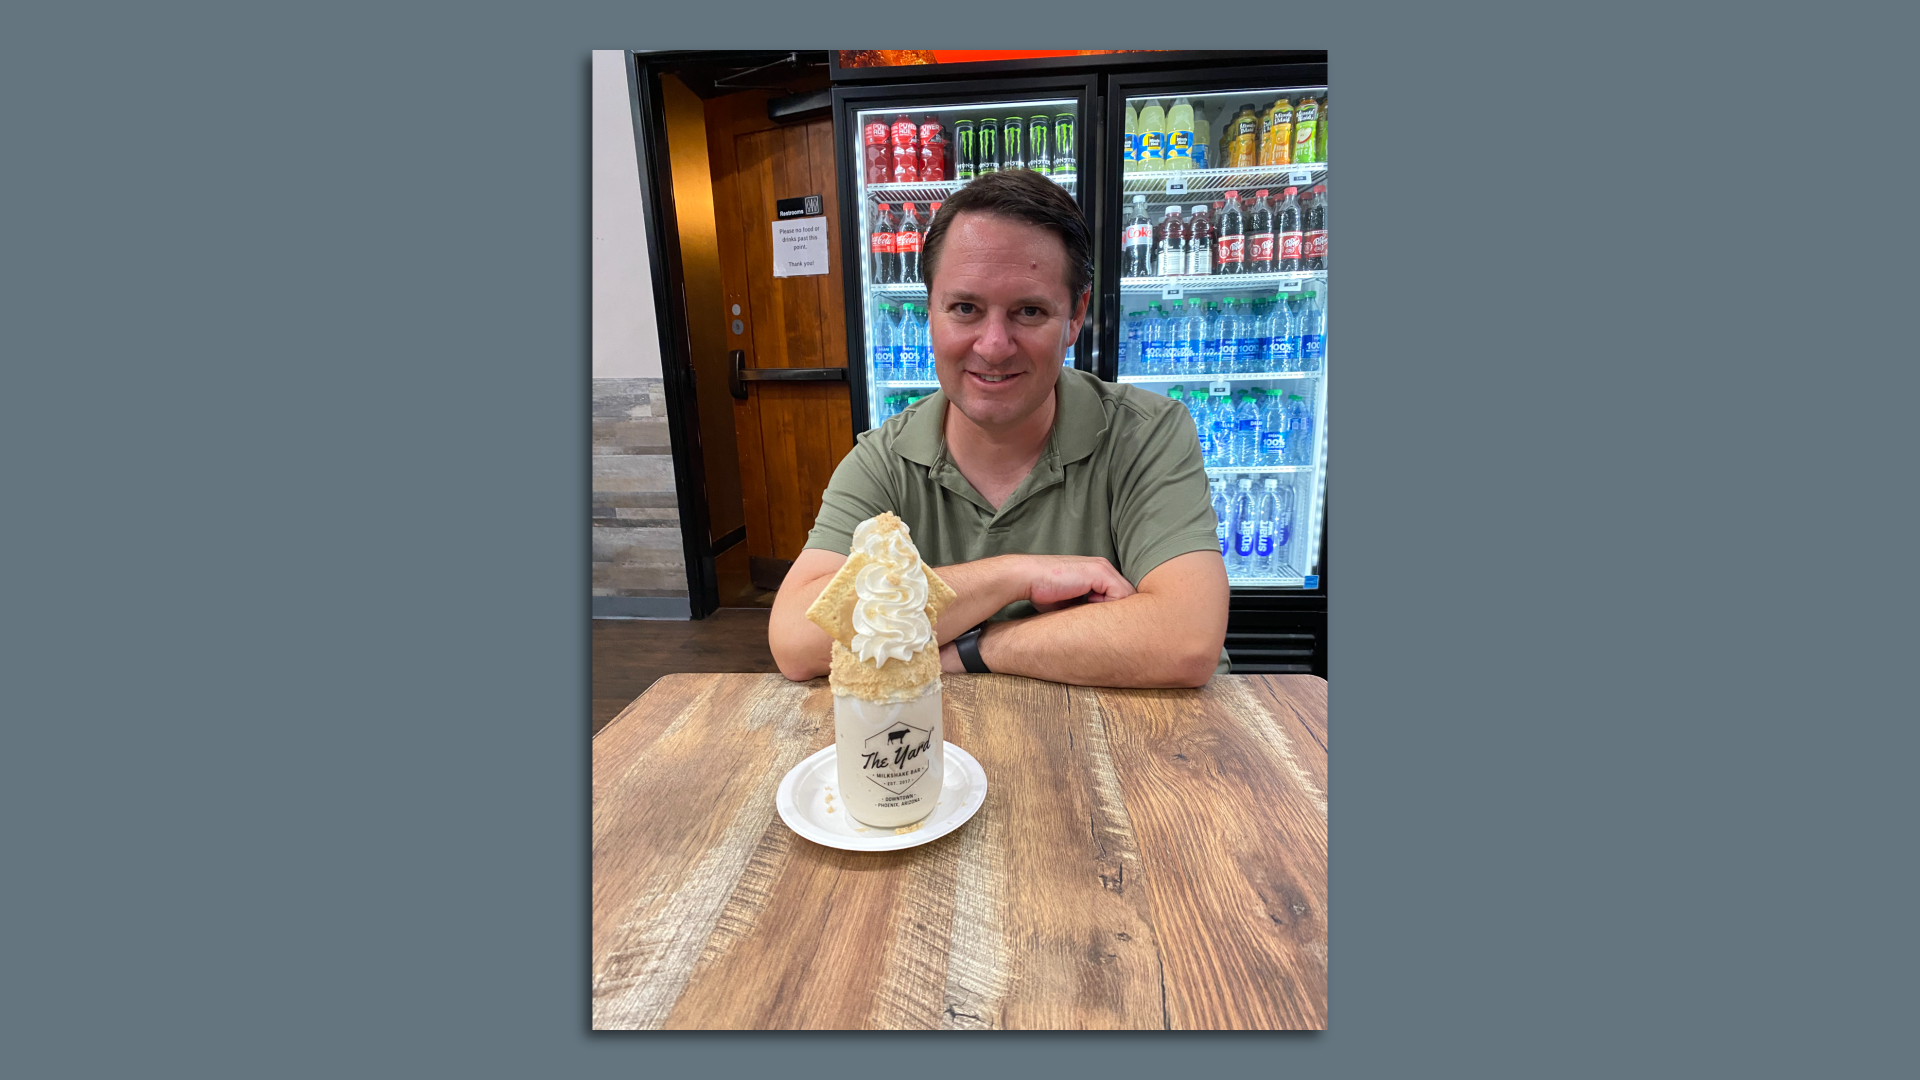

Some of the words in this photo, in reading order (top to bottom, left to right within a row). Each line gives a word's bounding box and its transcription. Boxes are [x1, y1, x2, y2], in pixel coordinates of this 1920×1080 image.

[1127, 226, 1152, 239] Coke
[1269, 343, 1292, 351] 100%
[900, 352, 920, 360] 100%
[1241, 521, 1251, 552] smart
[1258, 521, 1269, 552] smart
[861, 751, 889, 770] The
[894, 726, 935, 770] Yard
[876, 771, 909, 779] MILKSHAKE
[910, 767, 921, 775] BAR
[885, 793, 914, 802] DOWNTOWN
[901, 797, 920, 806] ARIZONA
